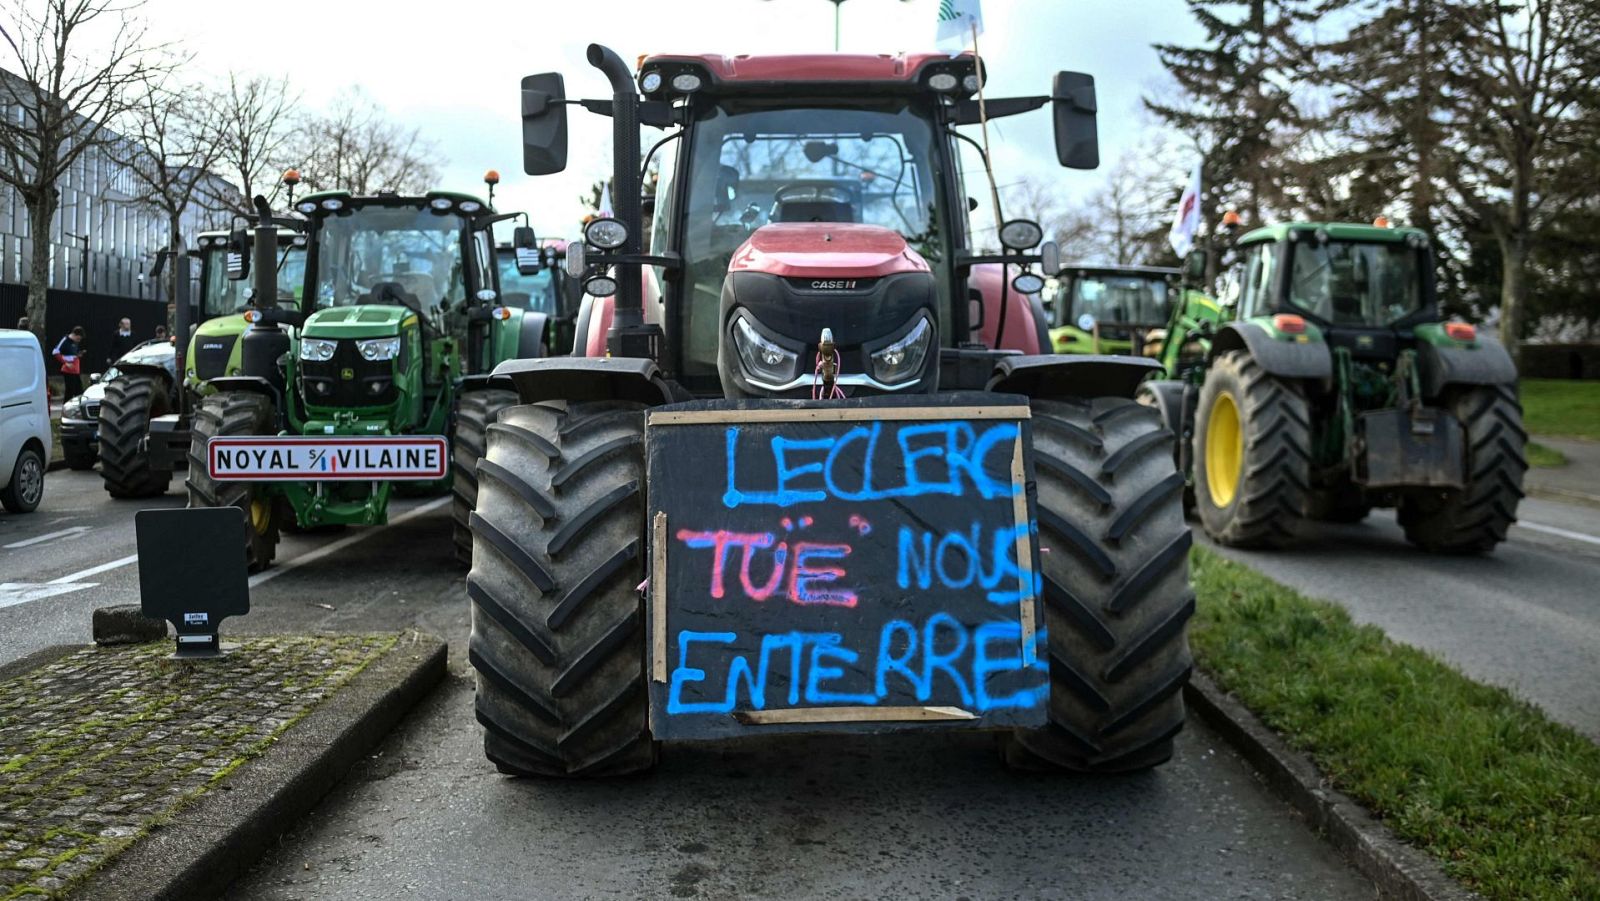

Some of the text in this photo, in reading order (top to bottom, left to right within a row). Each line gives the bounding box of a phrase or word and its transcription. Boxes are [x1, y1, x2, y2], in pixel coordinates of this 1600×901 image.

[811, 280, 844, 289] CASE
[217, 449, 299, 470] NOYAL
[337, 449, 437, 469] VILAINE
[722, 421, 1022, 507] LECLERC
[897, 521, 1042, 605] NOUS
[666, 612, 1049, 714] ENTERRE
